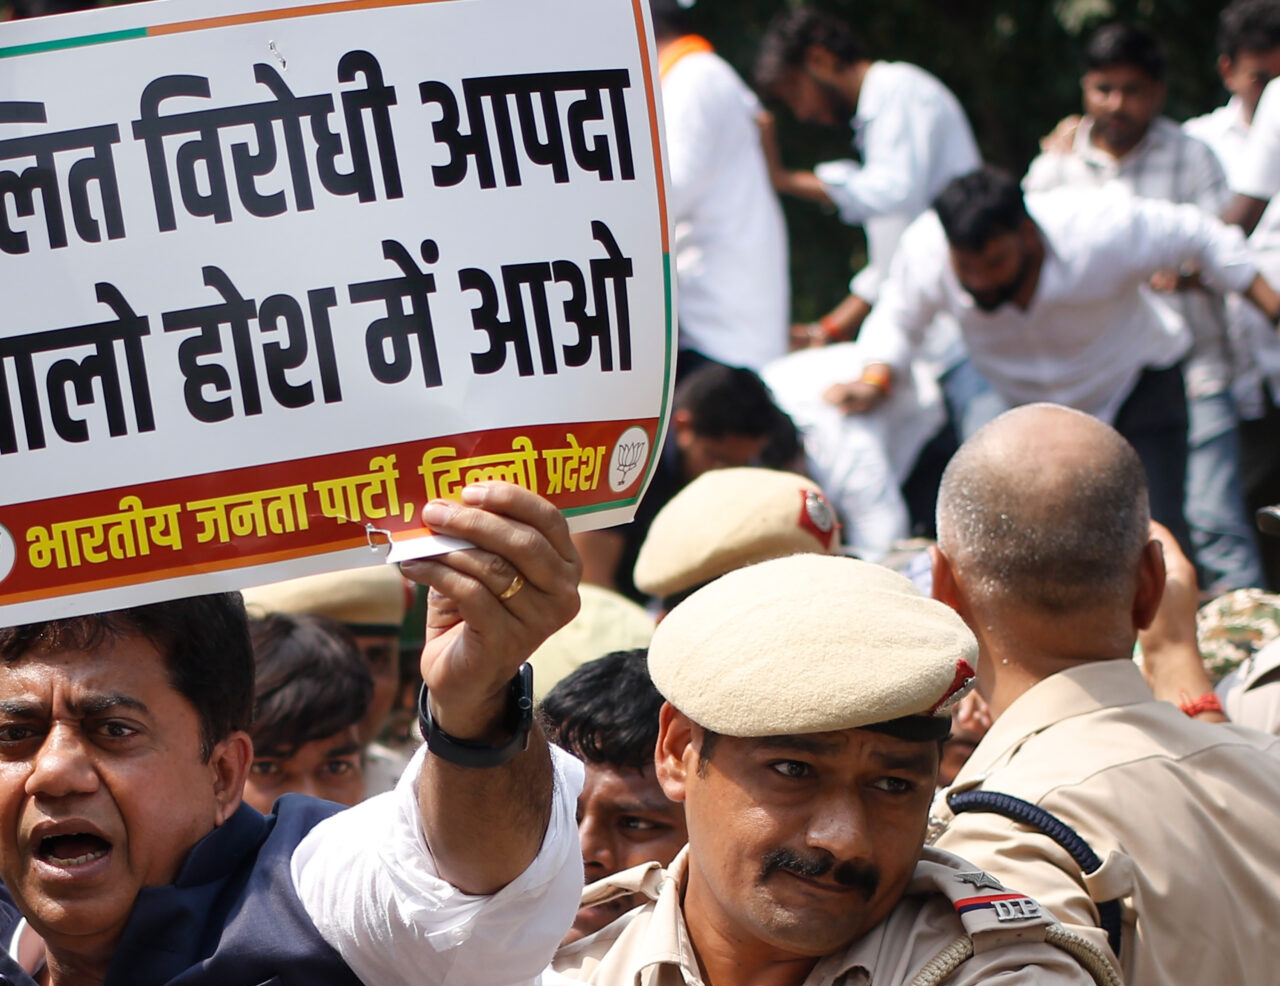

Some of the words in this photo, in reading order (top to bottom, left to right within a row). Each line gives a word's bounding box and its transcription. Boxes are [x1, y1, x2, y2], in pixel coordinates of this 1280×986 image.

[132, 50, 403, 231] विरोधी
[419, 69, 635, 189] आपदा
[162, 266, 342, 422] होश
[348, 239, 442, 387] में
[458, 221, 633, 376] आओ
[26, 495, 183, 569] भारतीय
[186, 484, 309, 543] जनता
[314, 454, 415, 523] पार्टी,
[543, 433, 606, 493] प्रदेश
